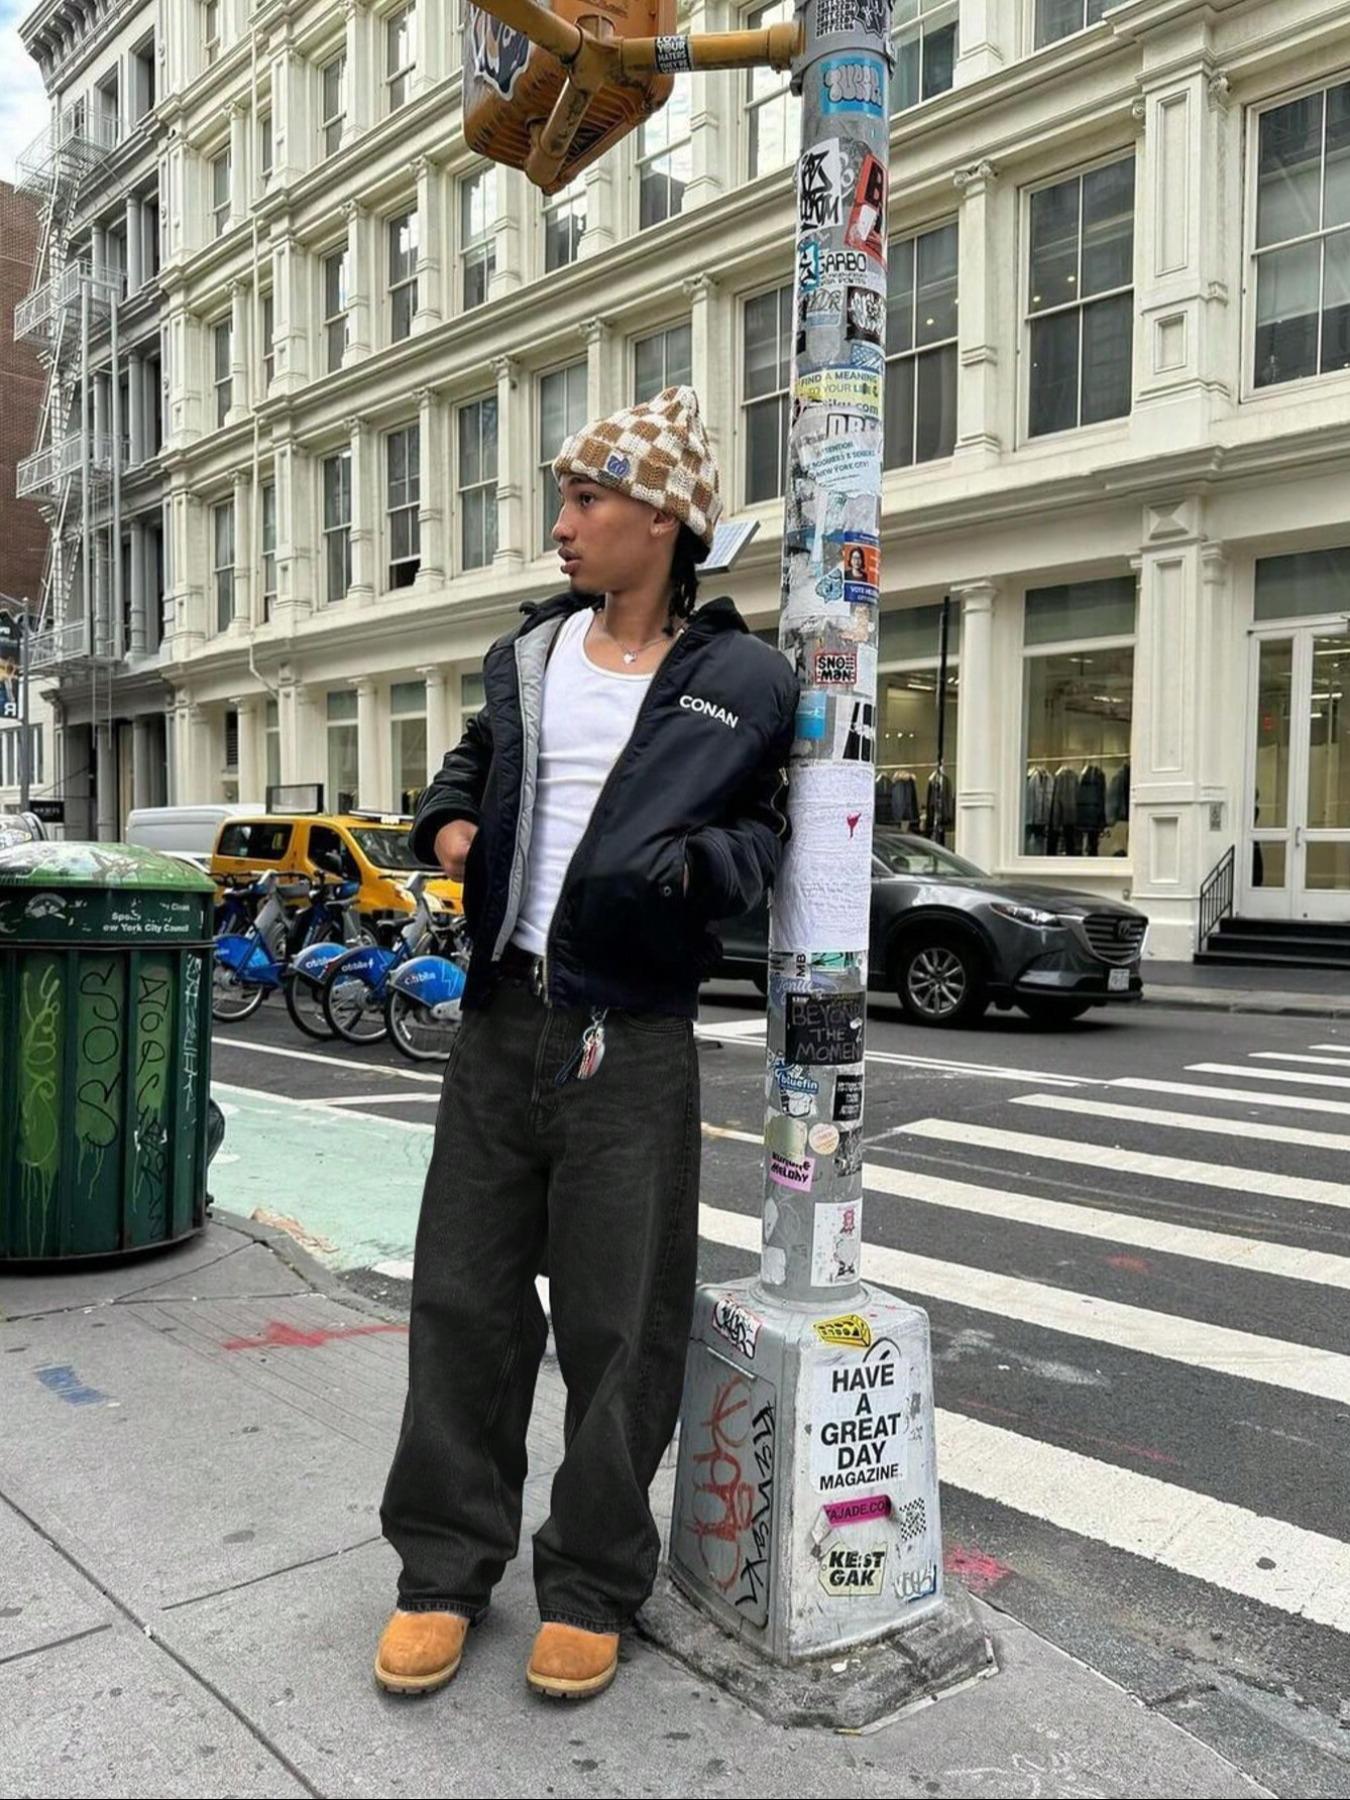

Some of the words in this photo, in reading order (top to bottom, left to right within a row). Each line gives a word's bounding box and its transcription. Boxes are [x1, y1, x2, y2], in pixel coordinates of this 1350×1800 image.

[680, 694, 739, 729] CONAN
[144, 923, 162, 934] City
[780, 1073, 818, 1090] bluefin
[831, 1363, 895, 1393] HAVE
[855, 1393, 872, 1416] A
[820, 1412, 902, 1446] GREAT
[837, 1441, 887, 1470] DAY
[819, 1463, 900, 1490] MAGAZINE
[829, 1569, 875, 1587] GAK
